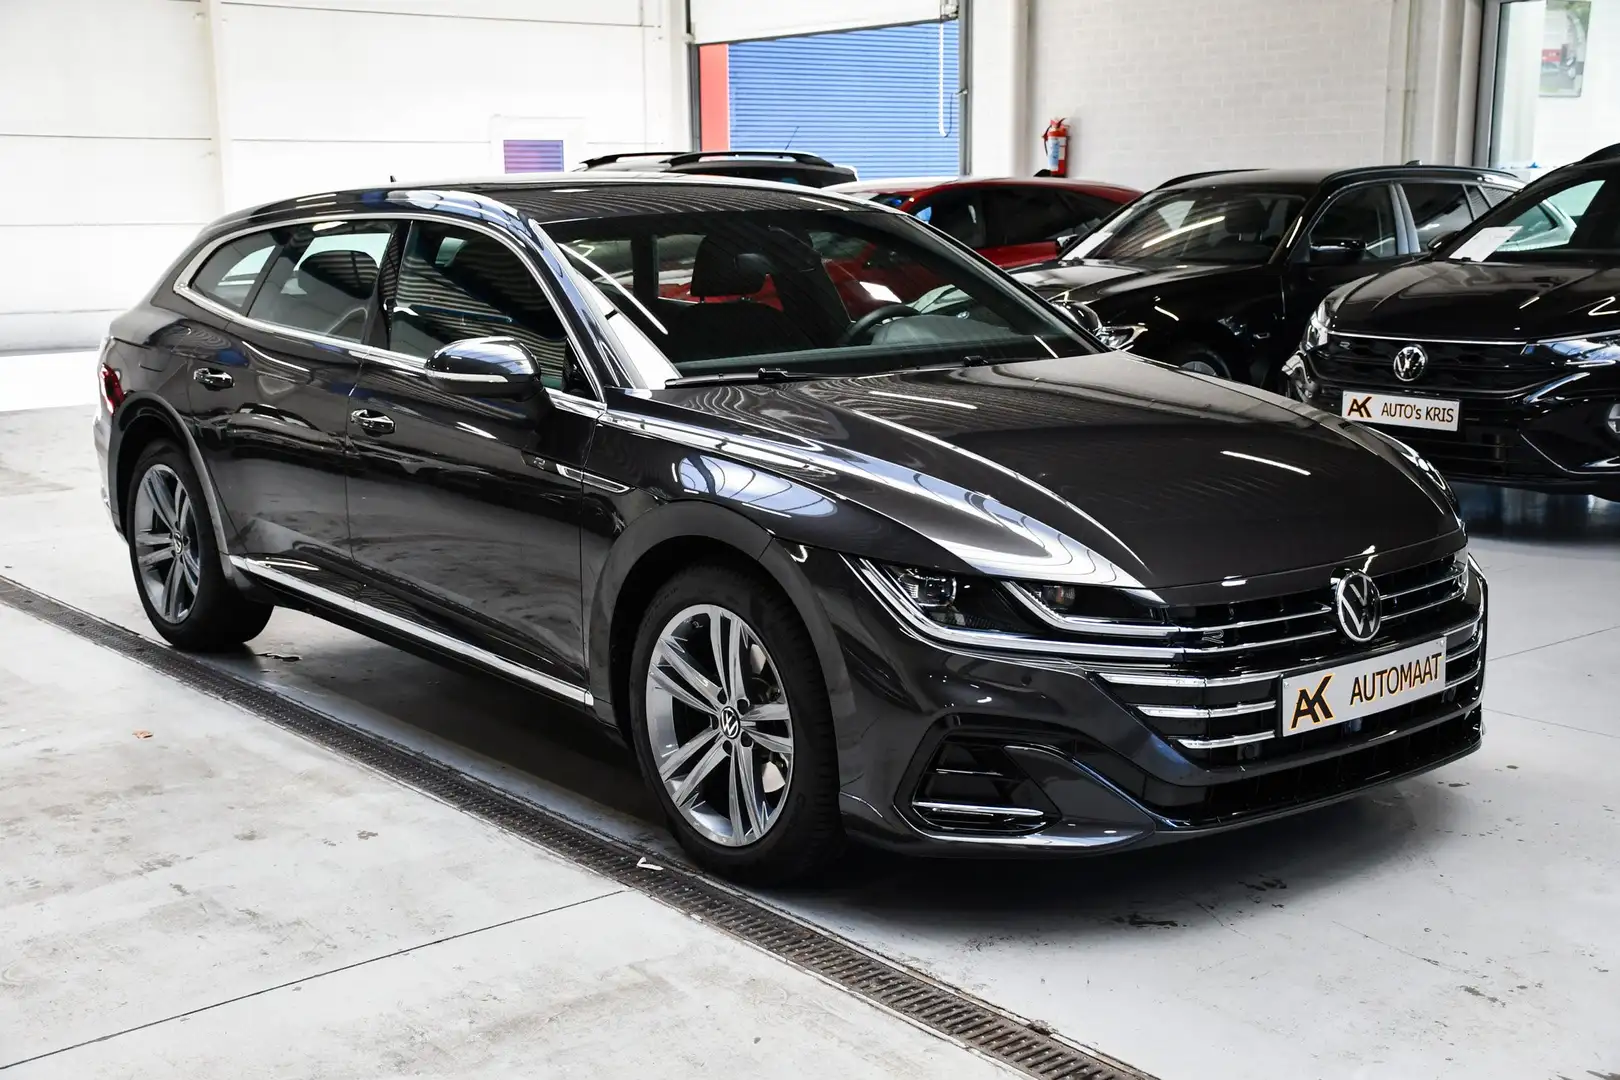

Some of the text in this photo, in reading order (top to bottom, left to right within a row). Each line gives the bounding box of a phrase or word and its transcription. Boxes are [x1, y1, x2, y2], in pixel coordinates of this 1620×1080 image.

[1347, 396, 1454, 423] AK AUTO's KRIS
[1290, 652, 1442, 729] AK AUTOMAAT
[721, 707, 739, 738] VW
